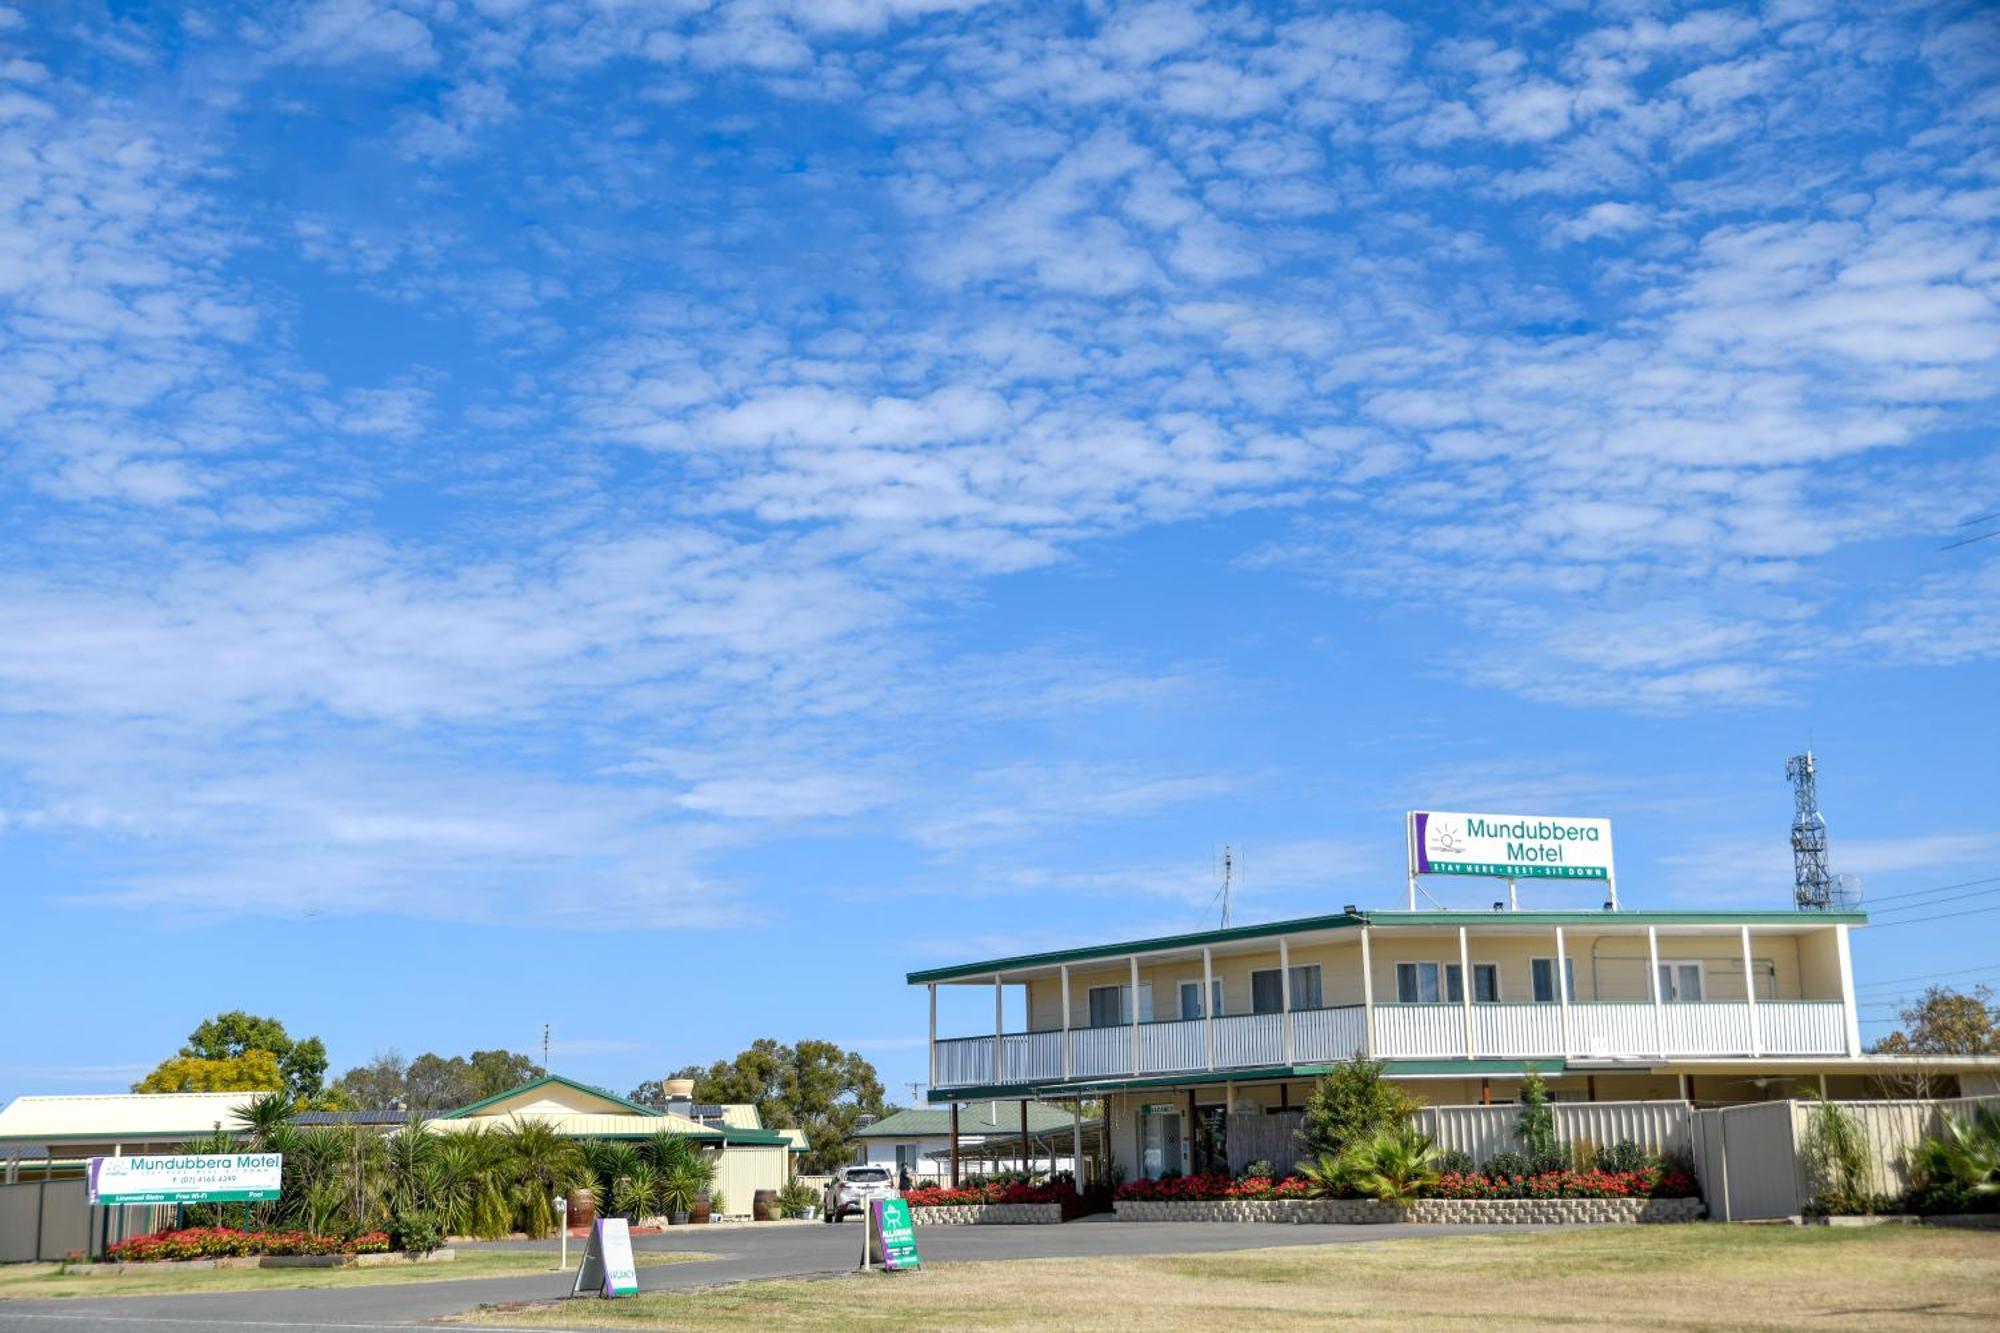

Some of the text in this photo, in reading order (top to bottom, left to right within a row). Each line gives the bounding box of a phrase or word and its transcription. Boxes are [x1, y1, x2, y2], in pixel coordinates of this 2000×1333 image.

[1467, 818, 1599, 841] Mundubbera
[1507, 842, 1563, 862] Motel
[1434, 863, 1461, 872] STAY
[1466, 865, 1496, 873] HERE
[1545, 867, 1564, 875] SIT
[1568, 868, 1601, 876] DOWN
[131, 1155, 280, 1170] Mundubbera Motel
[248, 1190, 264, 1199] Pool
